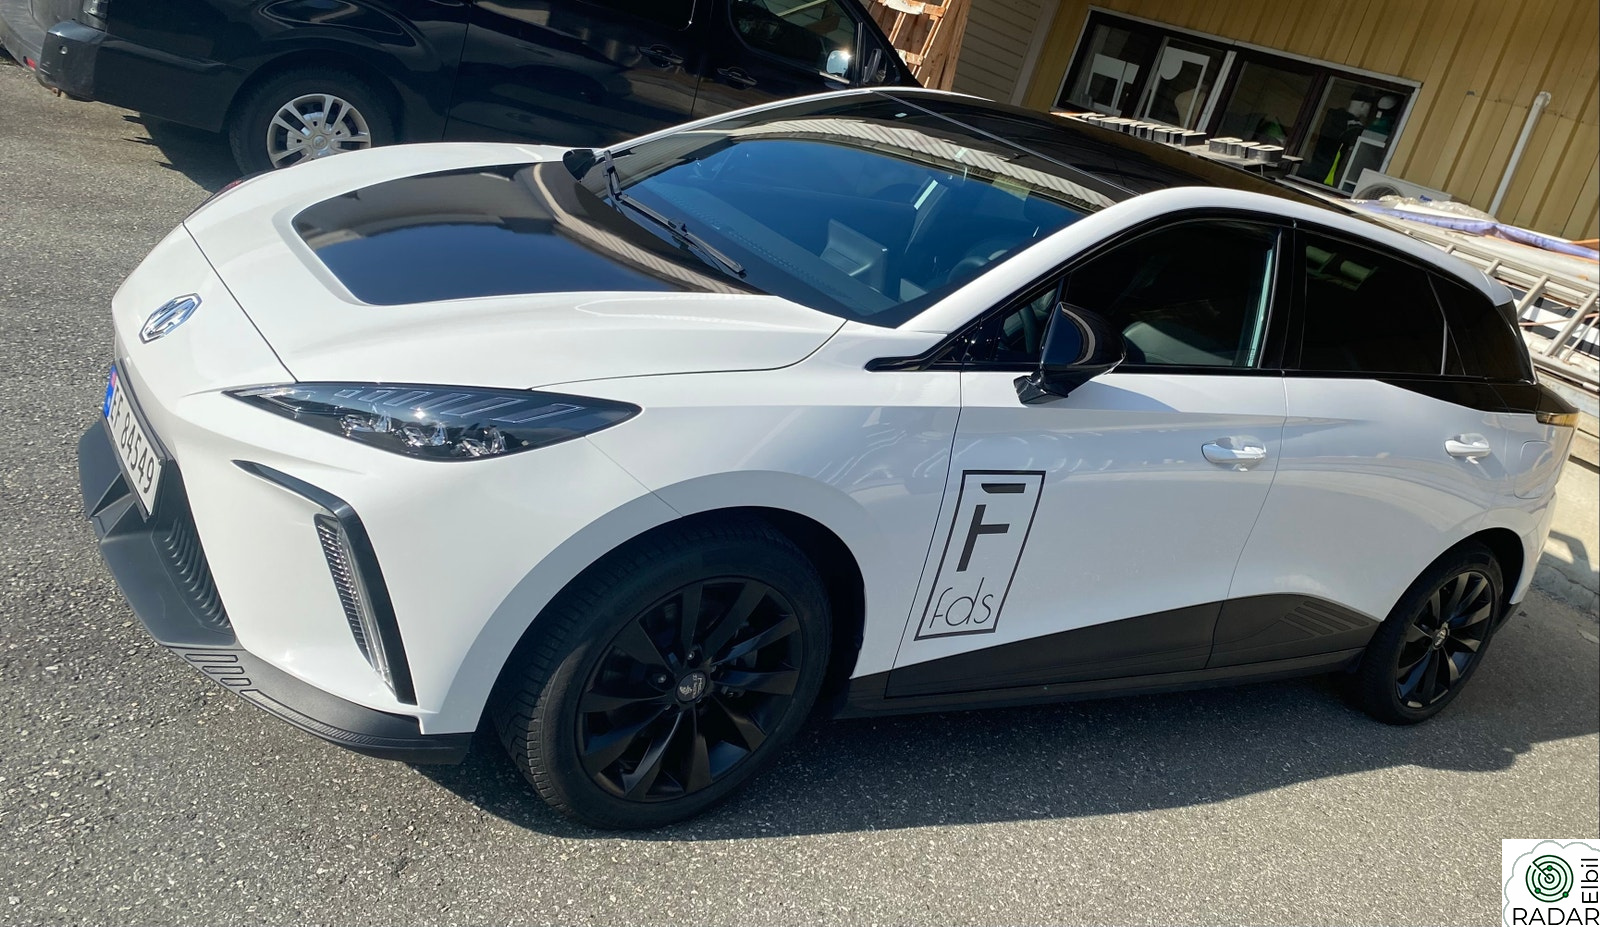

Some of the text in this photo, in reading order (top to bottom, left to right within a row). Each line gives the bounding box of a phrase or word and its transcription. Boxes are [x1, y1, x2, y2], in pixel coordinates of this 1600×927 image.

[111, 384, 155, 494] EF 84549
[956, 483, 1026, 571] F
